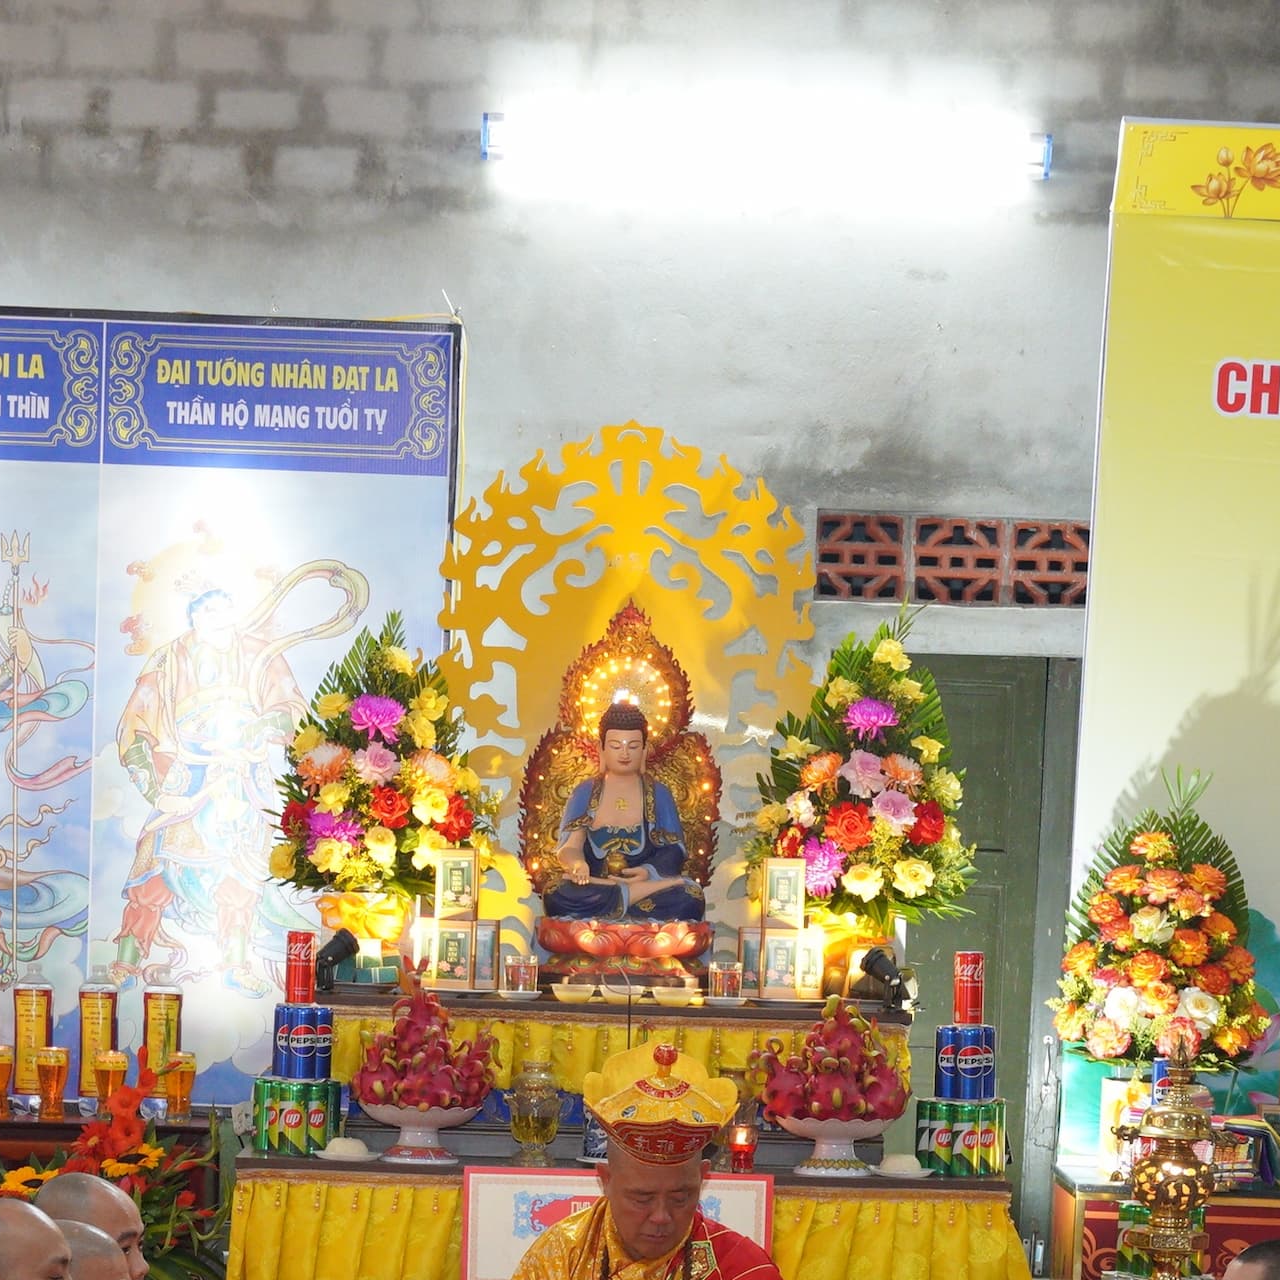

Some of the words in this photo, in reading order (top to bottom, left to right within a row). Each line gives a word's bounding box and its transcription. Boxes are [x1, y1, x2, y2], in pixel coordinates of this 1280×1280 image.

[17, 353, 45, 379] LA
[156, 358, 191, 388] ĐẠI
[196, 356, 265, 387] TƯỚNG
[271, 358, 326, 390] NHÂN
[332, 365, 369, 395] ĐẠT
[374, 366, 399, 393] LA
[7, 391, 50, 419] THÌN
[166, 393, 216, 426] THẦN
[221, 398, 249, 430] HỘ
[254, 404, 310, 432] MẠNG
[315, 398, 359, 430] TUỔI
[364, 408, 387, 435] TỴ
